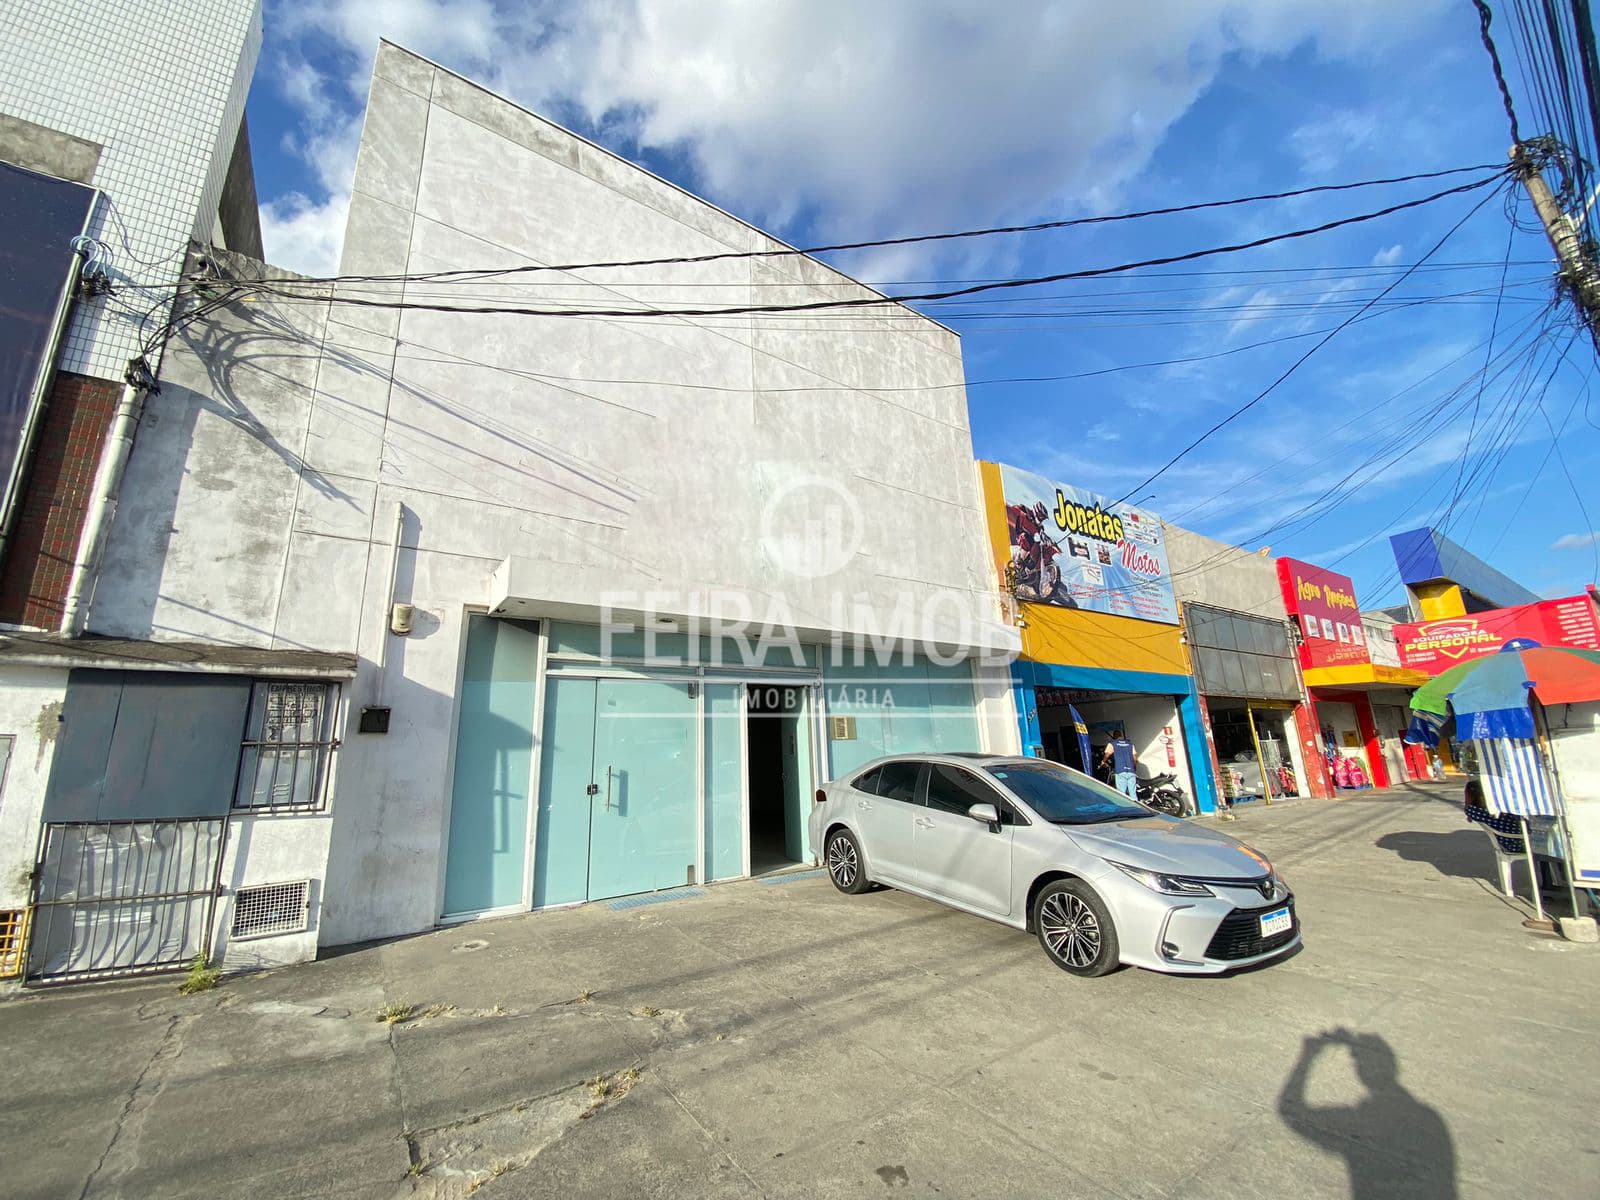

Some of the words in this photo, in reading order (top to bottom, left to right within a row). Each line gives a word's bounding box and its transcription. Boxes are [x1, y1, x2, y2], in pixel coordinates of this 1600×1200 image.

[1054, 489, 1124, 544] Jonatas
[1117, 538, 1161, 575] Motos
[1297, 575, 1321, 601] Agro
[1405, 633, 1502, 652] PERSONAL
